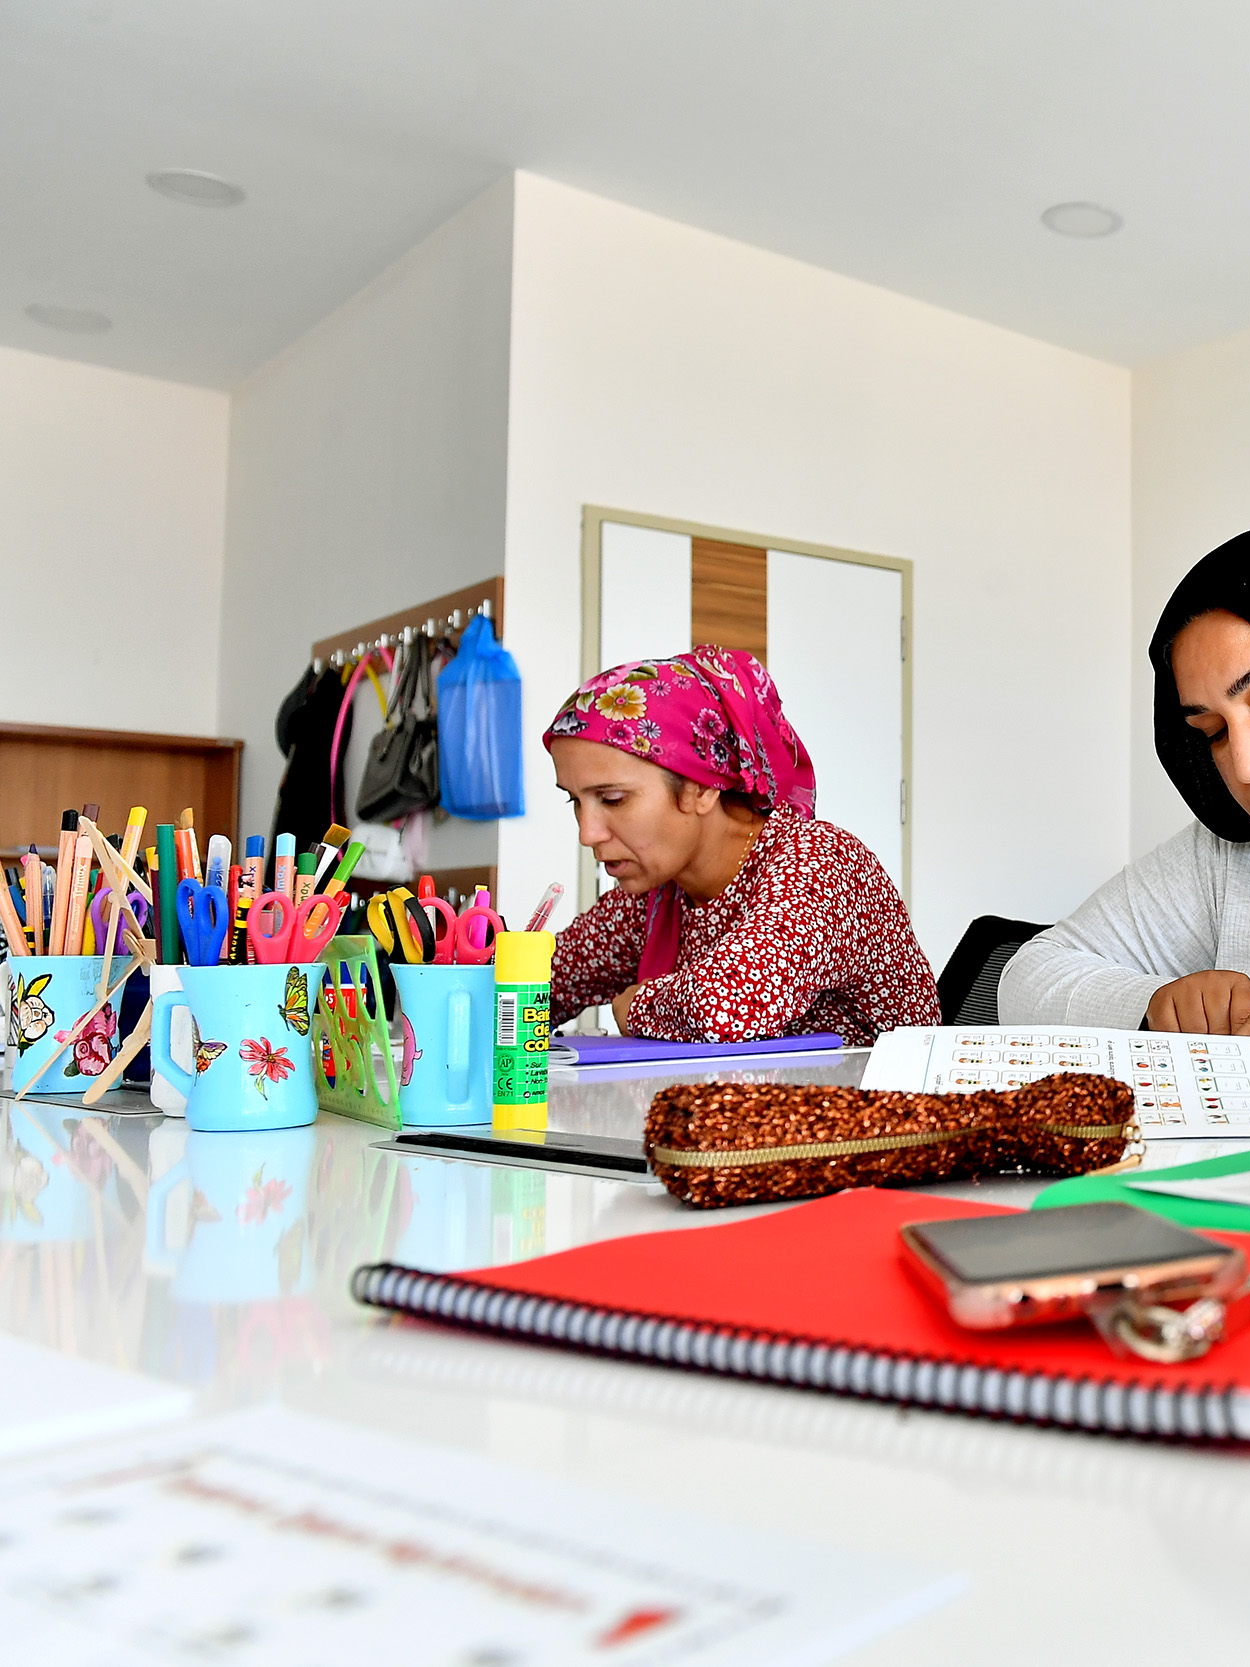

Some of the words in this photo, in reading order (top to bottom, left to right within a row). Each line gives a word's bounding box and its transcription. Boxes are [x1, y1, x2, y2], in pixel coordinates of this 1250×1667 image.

[73, 864, 88, 898] Trimax
[533, 1023, 550, 1037] de
[500, 1059, 513, 1068] AP
[498, 1078, 513, 1090] CE
